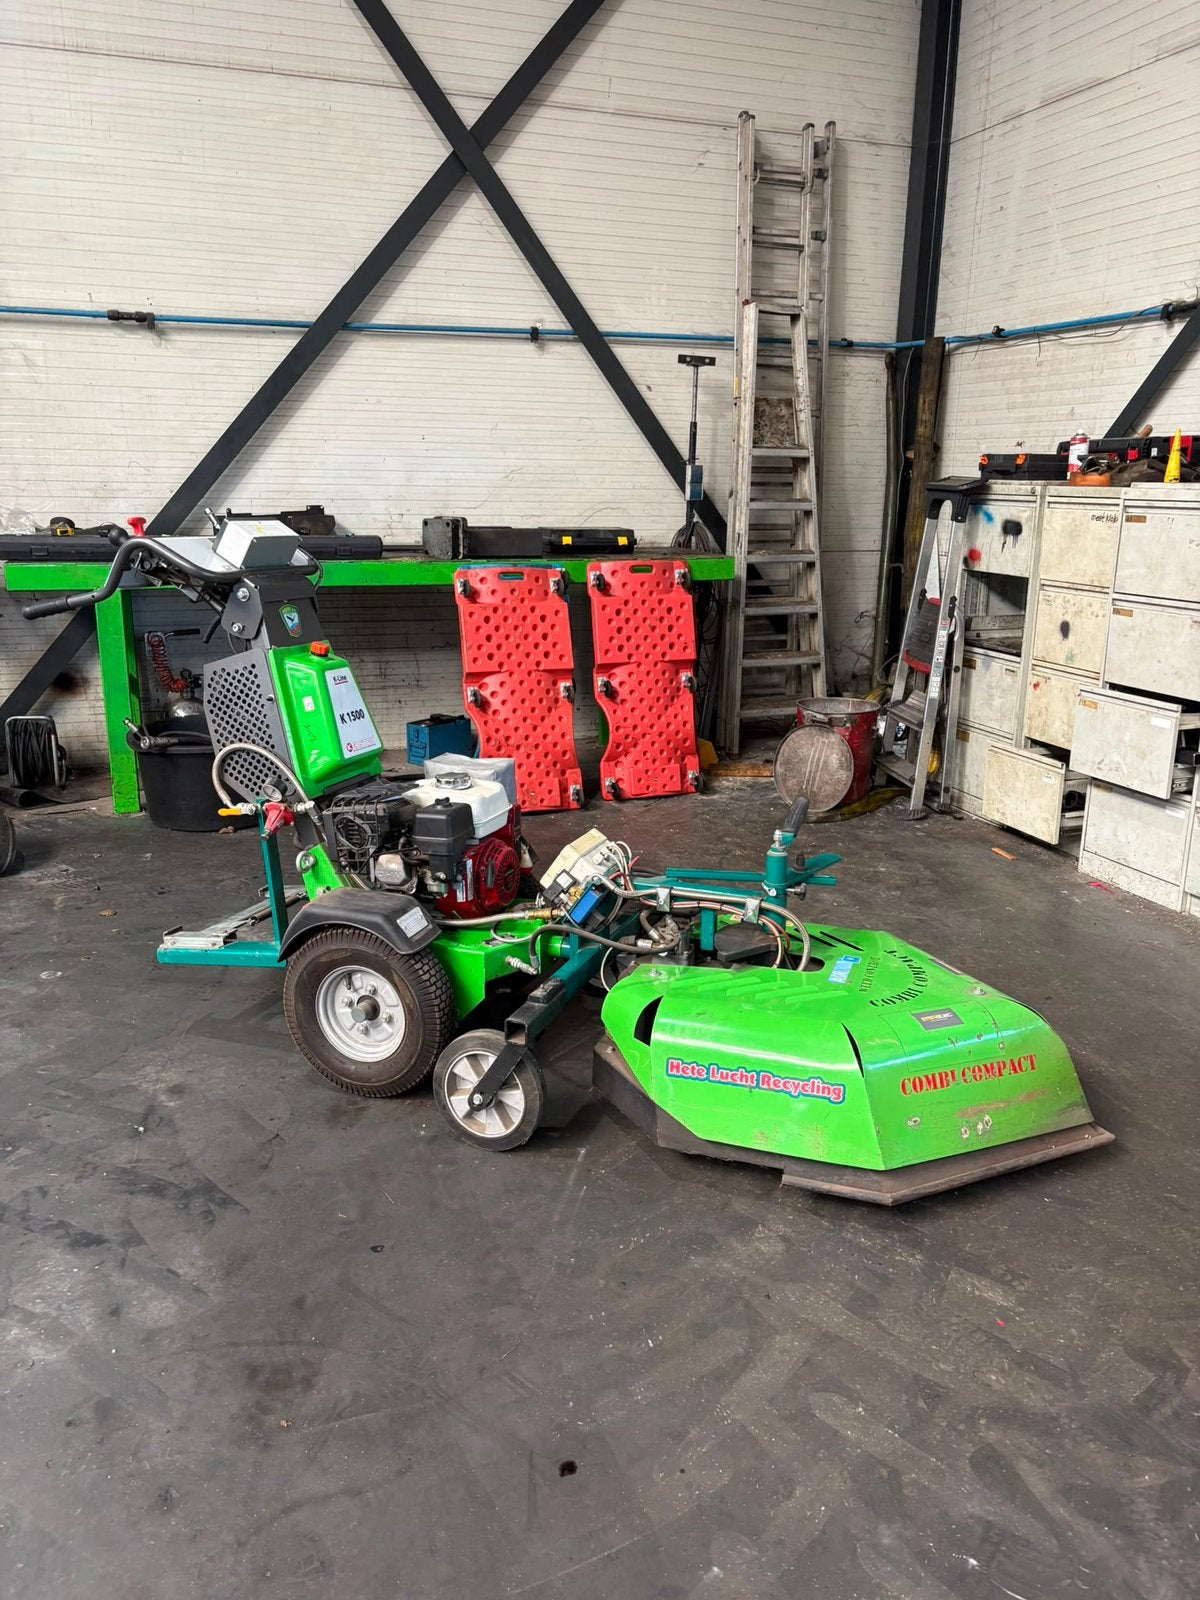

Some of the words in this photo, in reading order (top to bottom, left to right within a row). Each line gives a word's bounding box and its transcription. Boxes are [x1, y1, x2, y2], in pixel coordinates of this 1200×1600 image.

[339, 713, 347, 725] K
[347, 708, 365, 723] 1500
[668, 1058, 706, 1079] Hete
[709, 1065, 757, 1087] Lucht
[759, 1072, 844, 1103] Recycling
[900, 1069, 957, 1096] COMBI
[960, 1053, 1037, 1085] COMPACT
